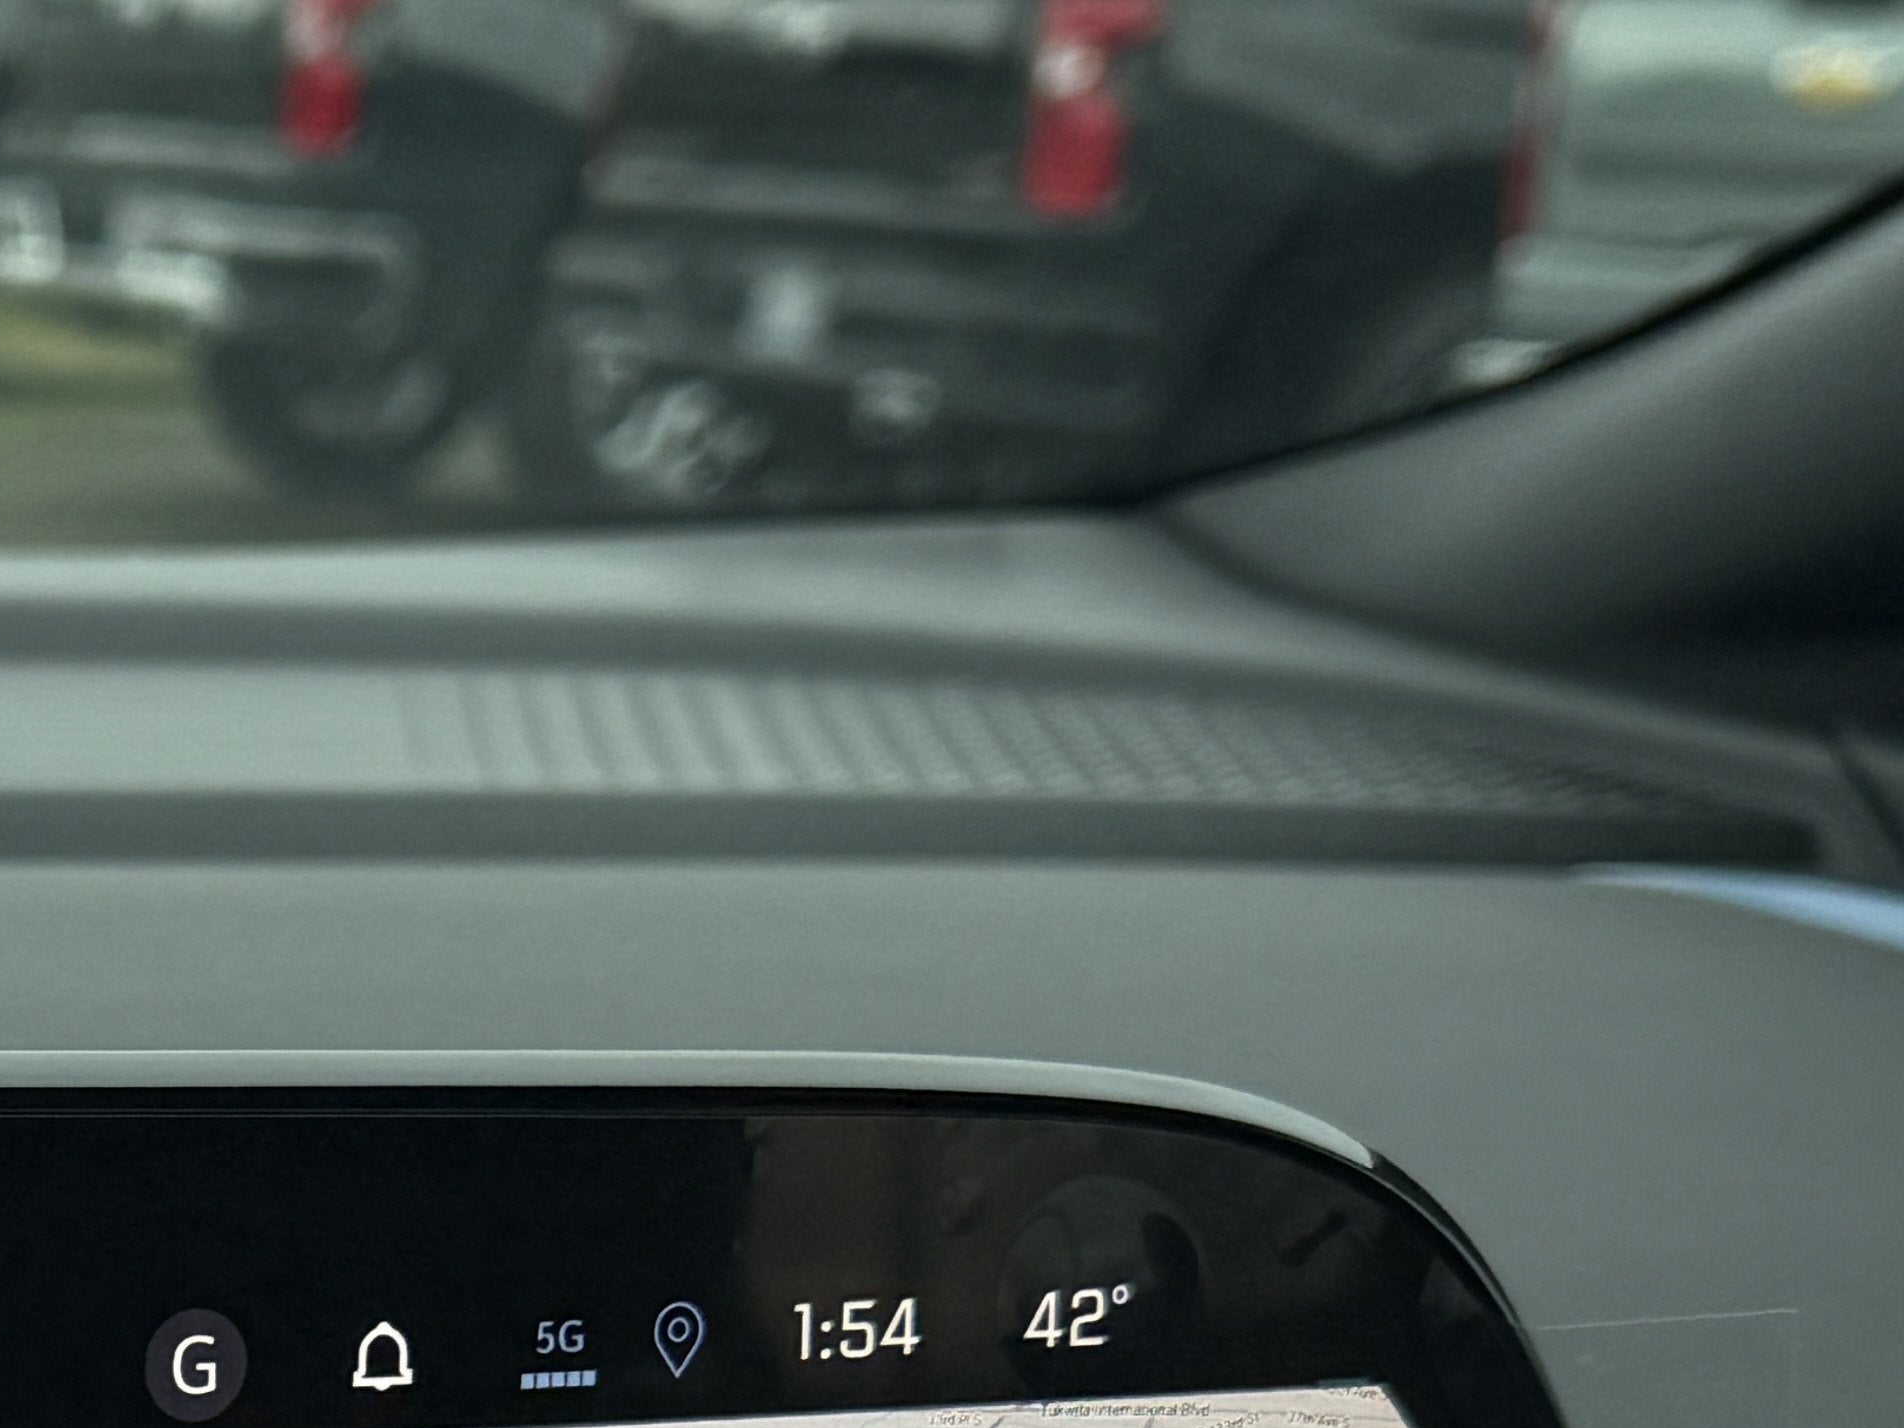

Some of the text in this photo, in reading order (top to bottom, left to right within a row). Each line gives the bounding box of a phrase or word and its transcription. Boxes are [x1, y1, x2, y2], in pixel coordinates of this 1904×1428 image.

[536, 1319, 585, 1353] 5G
[795, 1299, 920, 1359] 1:54
[171, 1334, 218, 1393] G
